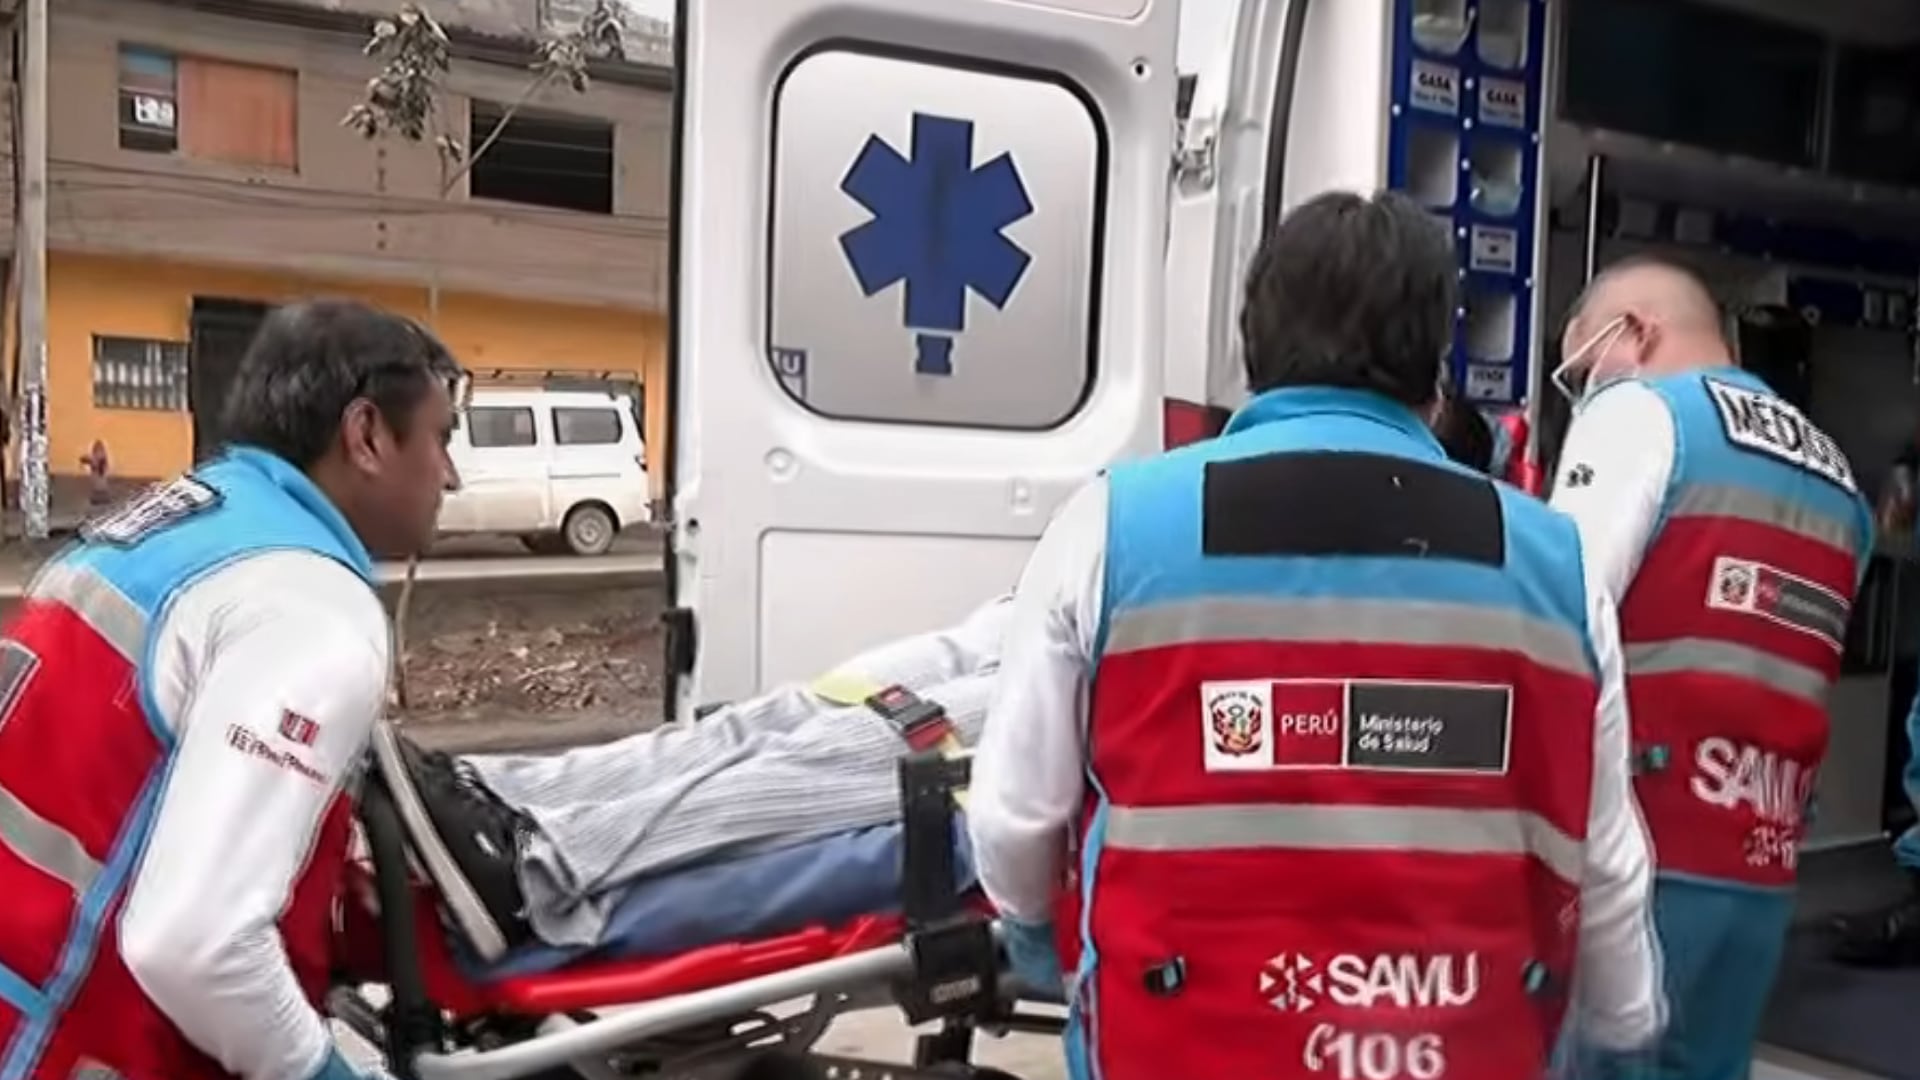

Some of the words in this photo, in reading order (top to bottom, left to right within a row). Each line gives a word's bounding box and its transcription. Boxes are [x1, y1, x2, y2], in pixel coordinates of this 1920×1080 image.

[1280, 709, 1338, 736] PERÚ
[1359, 713, 1444, 735] Ministerio
[1358, 732, 1381, 751] de
[1383, 732, 1431, 753] Salud
[1327, 951, 1478, 1007] SAMU
[1325, 1032, 1445, 1080] 106
